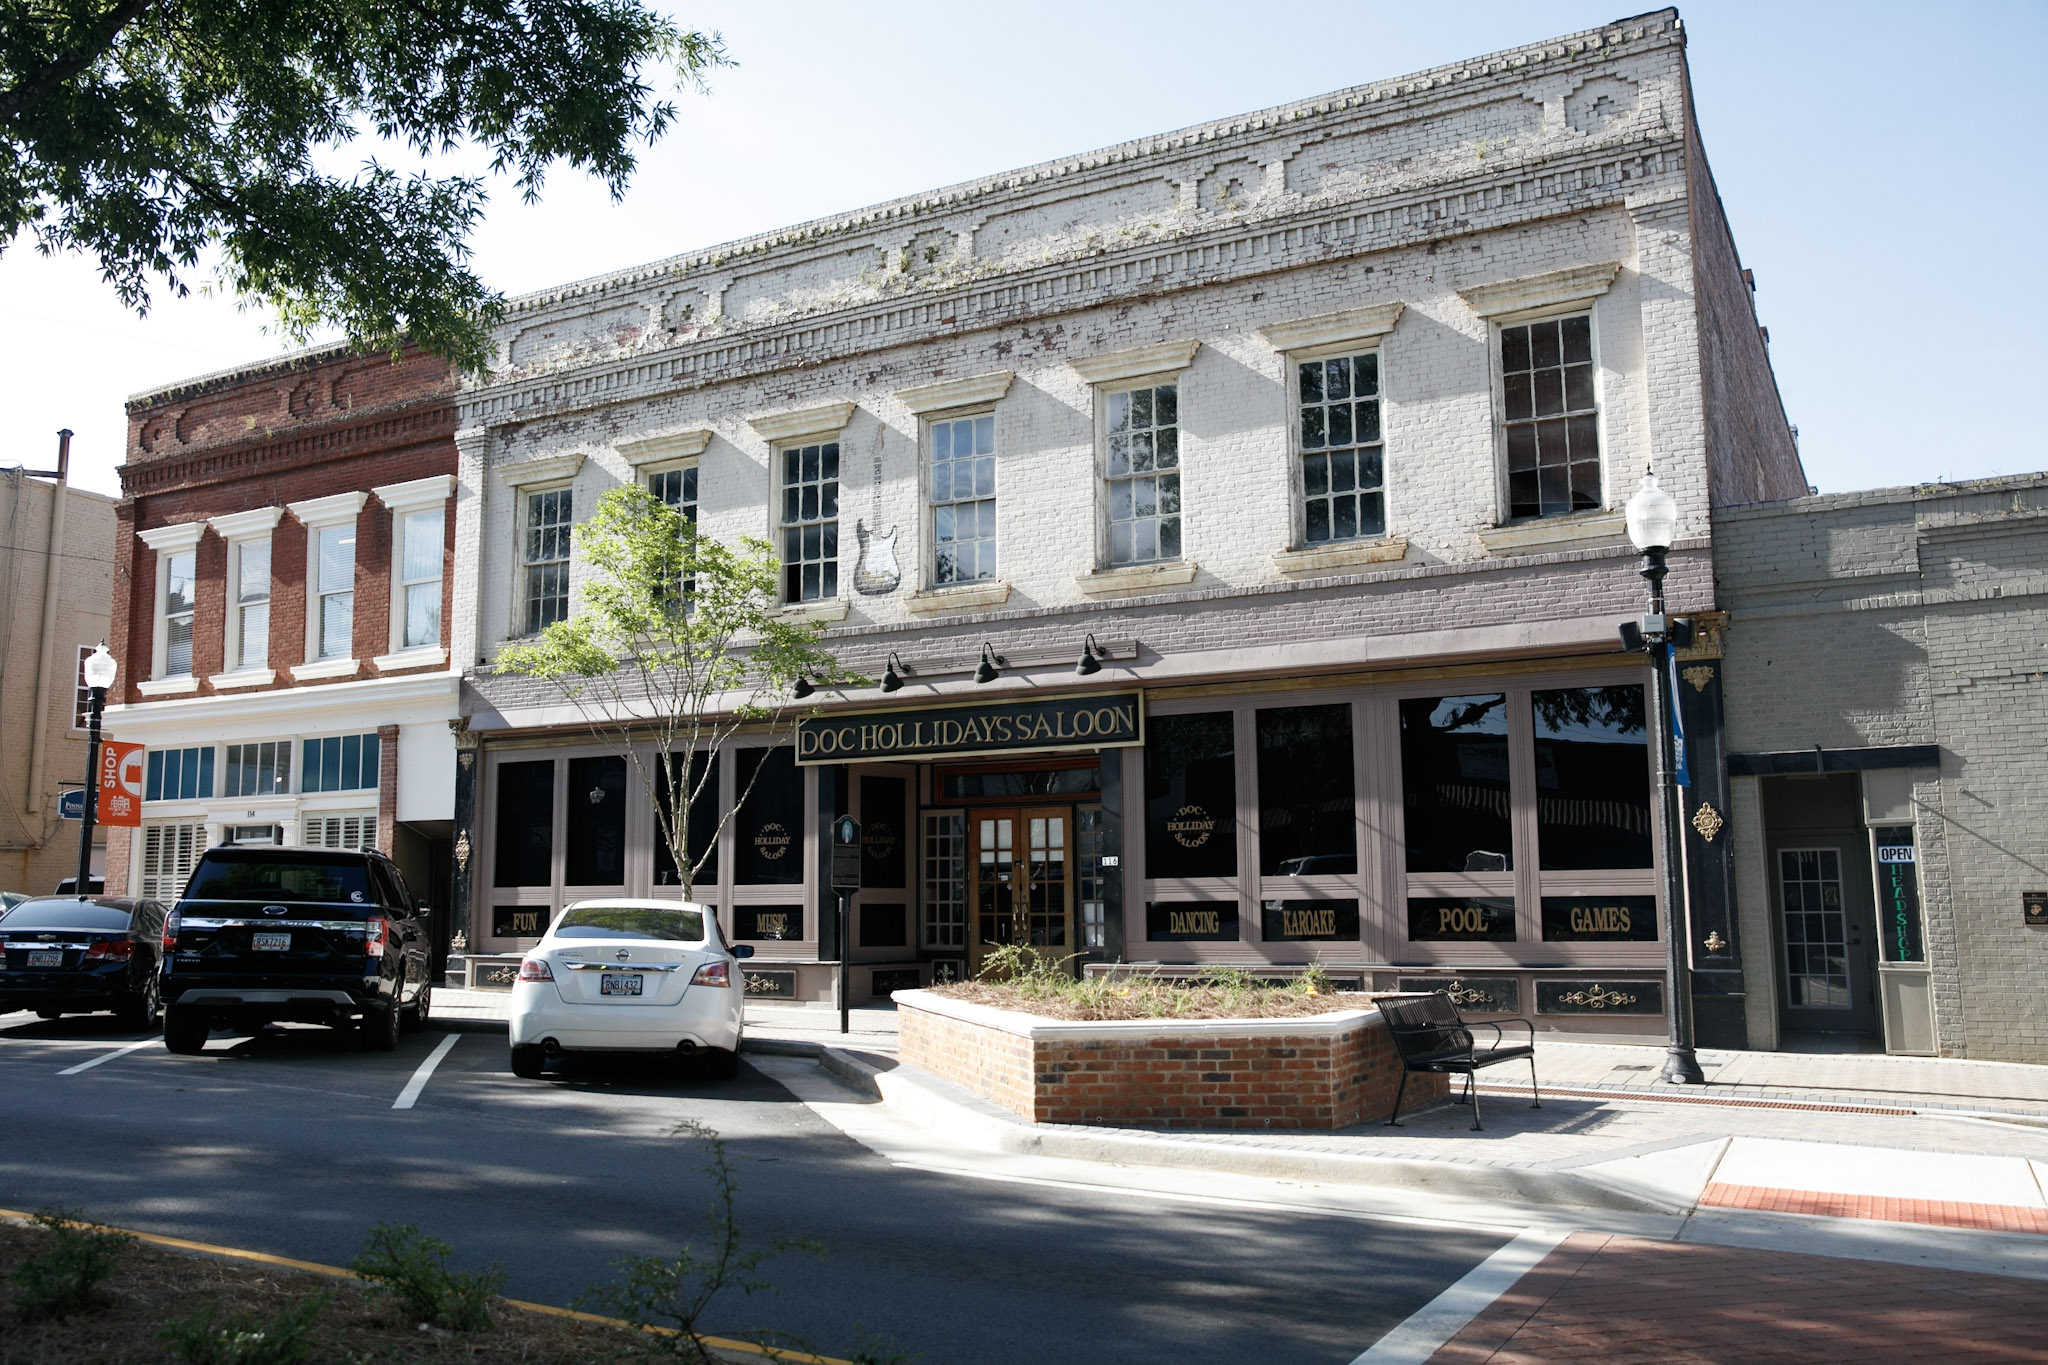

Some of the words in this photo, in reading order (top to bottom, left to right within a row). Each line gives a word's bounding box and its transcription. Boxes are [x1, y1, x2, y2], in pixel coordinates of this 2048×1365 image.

[800, 728, 857, 755] DOC
[1016, 704, 1136, 741] SALOON
[104, 747, 117, 789] SHOP
[247, 810, 255, 818] 114
[1178, 805, 1203, 816] DOC
[763, 822, 782, 833] DOC
[1167, 820, 1215, 831] HOLLIDAY
[754, 835, 791, 846] HOLLIDAY
[1174, 831, 1210, 848] SALOON
[759, 846, 787, 860] SALOON
[1103, 857, 1118, 865] 116
[1881, 847, 1912, 861] OPEN
[512, 911, 538, 931] FUN
[756, 913, 788, 933] MUSIC
[1169, 910, 1220, 934] DANCING
[1282, 909, 1337, 936] KAROAKE
[1439, 907, 1489, 932] POOL
[1570, 906, 1632, 933] GAMES
